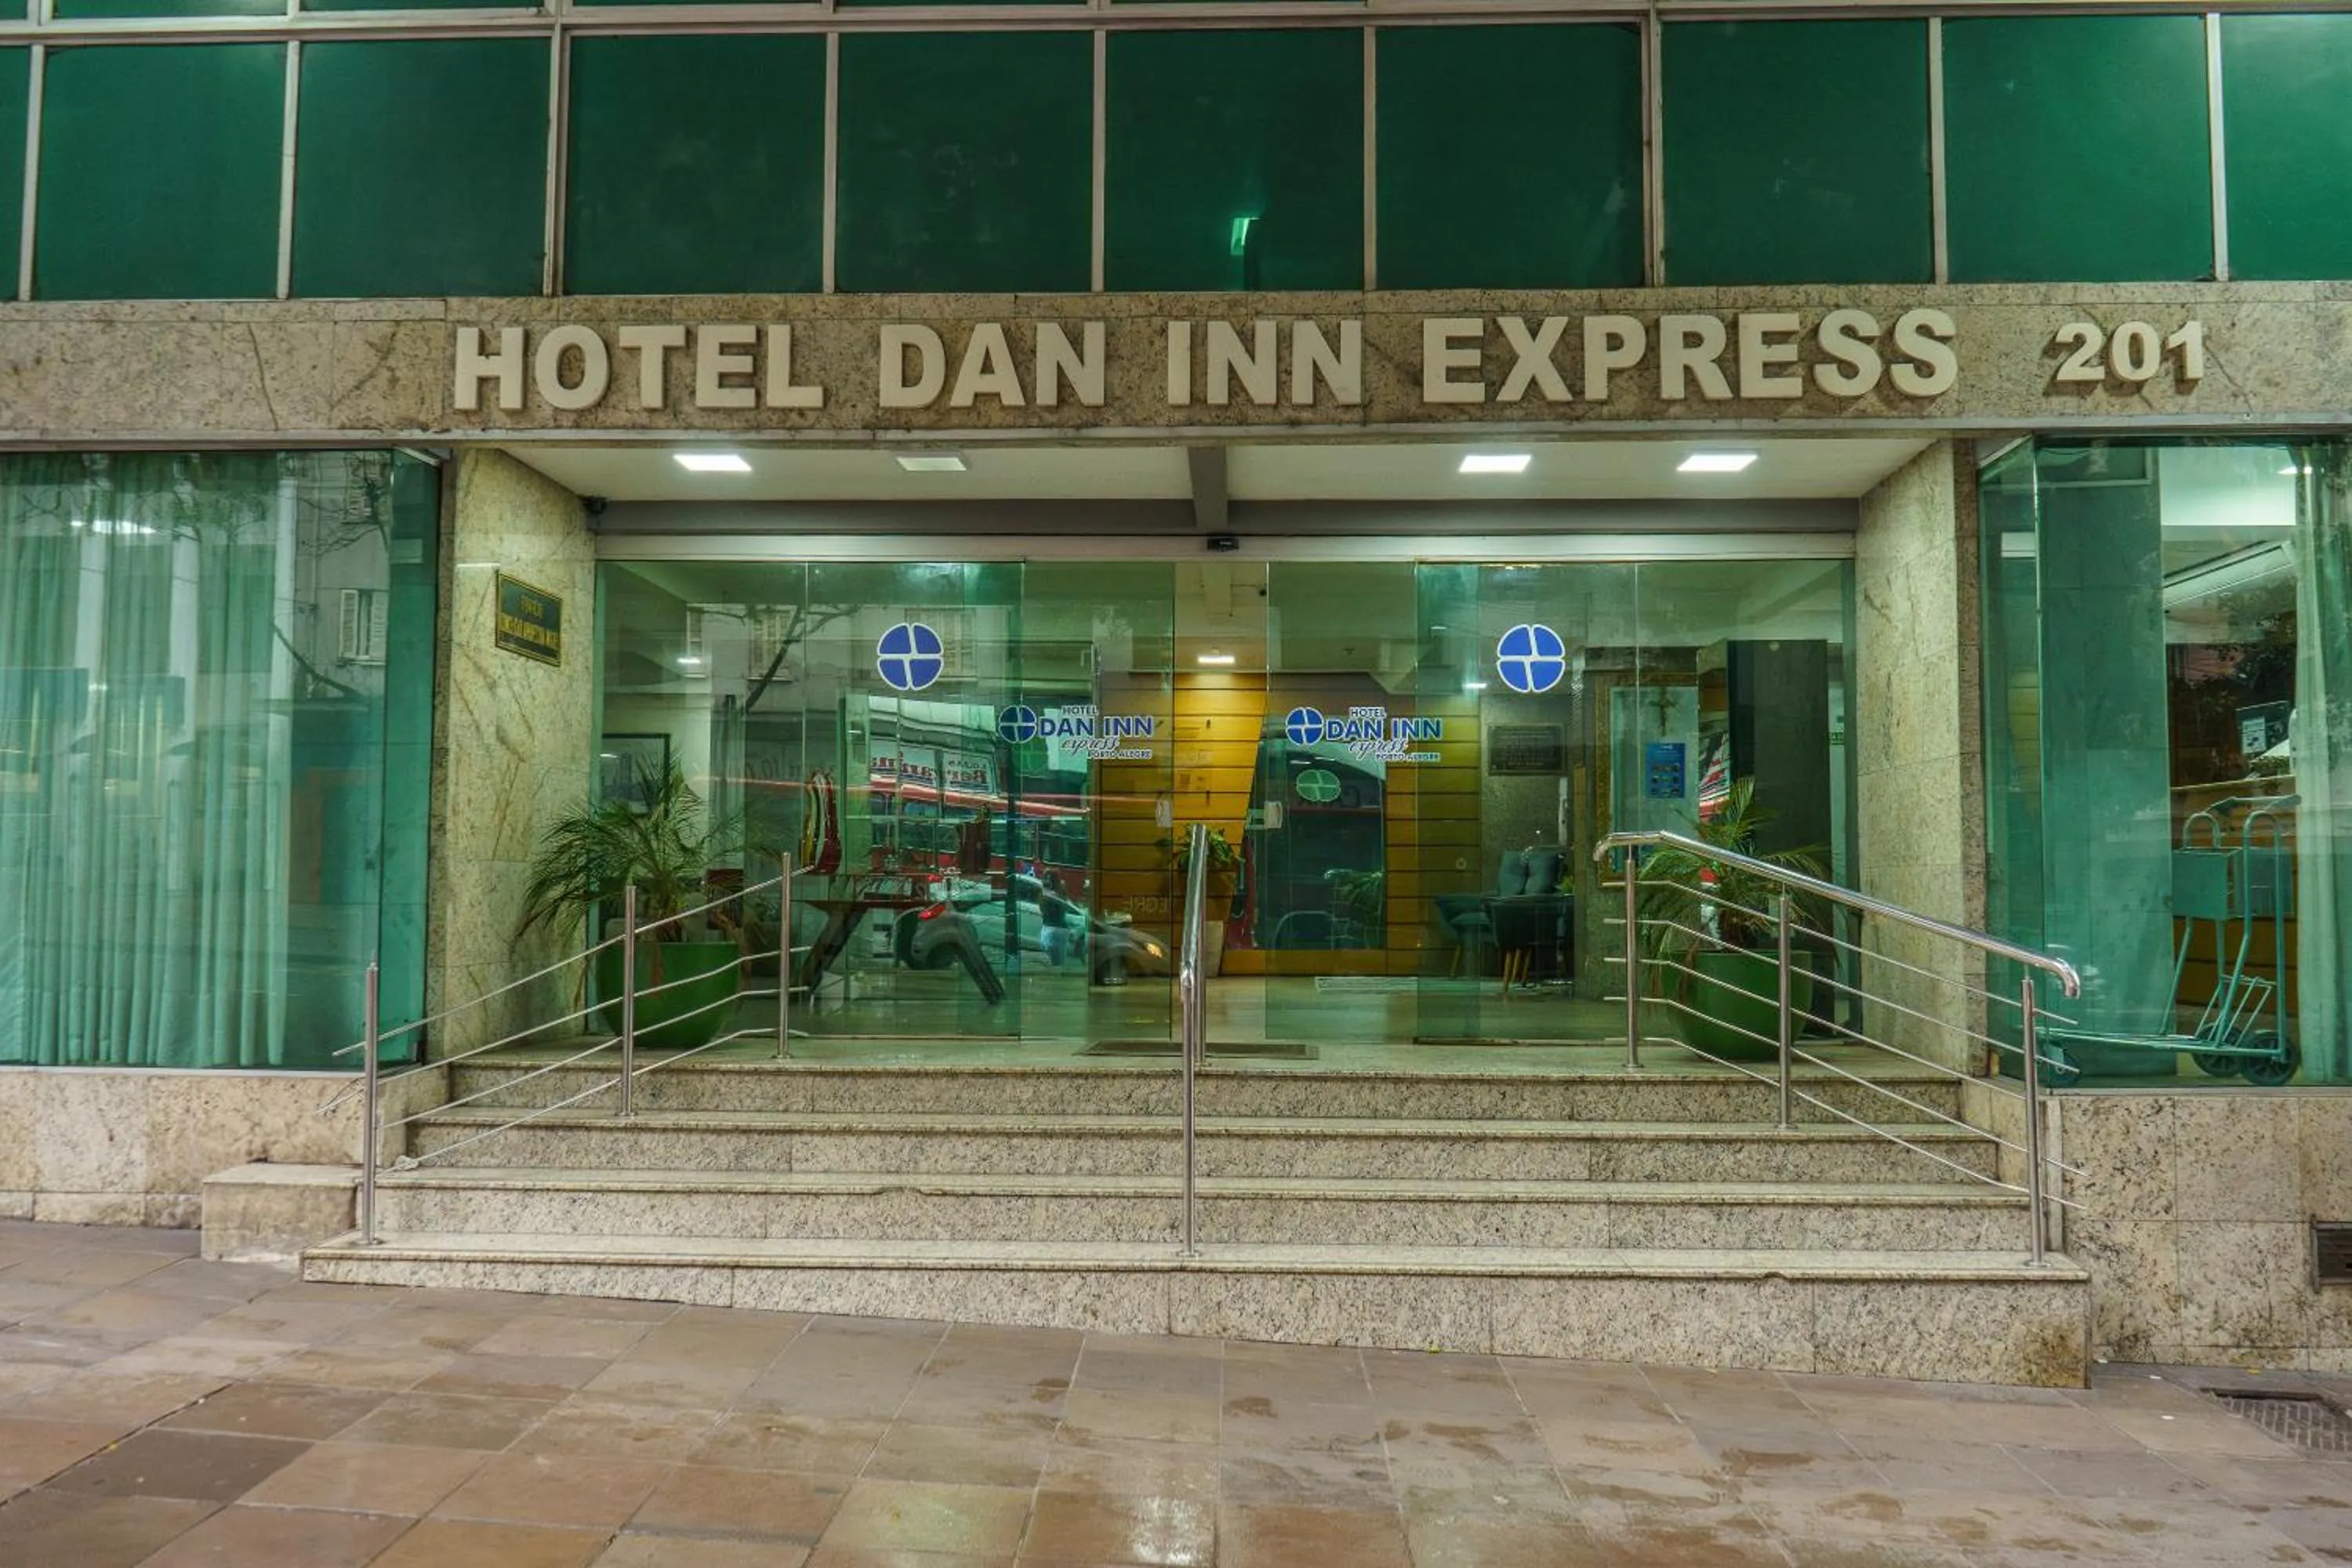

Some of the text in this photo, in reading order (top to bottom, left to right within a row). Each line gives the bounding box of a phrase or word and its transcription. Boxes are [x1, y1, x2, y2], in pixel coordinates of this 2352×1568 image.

[453, 307, 1958, 412] HOTEL DAN INN EXPRESS
[2053, 320, 2205, 384] 201
[1062, 706, 1098, 716] HOTEL
[1350, 707, 1386, 718] HOTEL
[1040, 716, 1153, 737] DAN INN
[1327, 718, 1442, 739] DAN INN
[1087, 750, 1152, 759] PORTO ALEGRE
[1349, 739, 1408, 760] express
